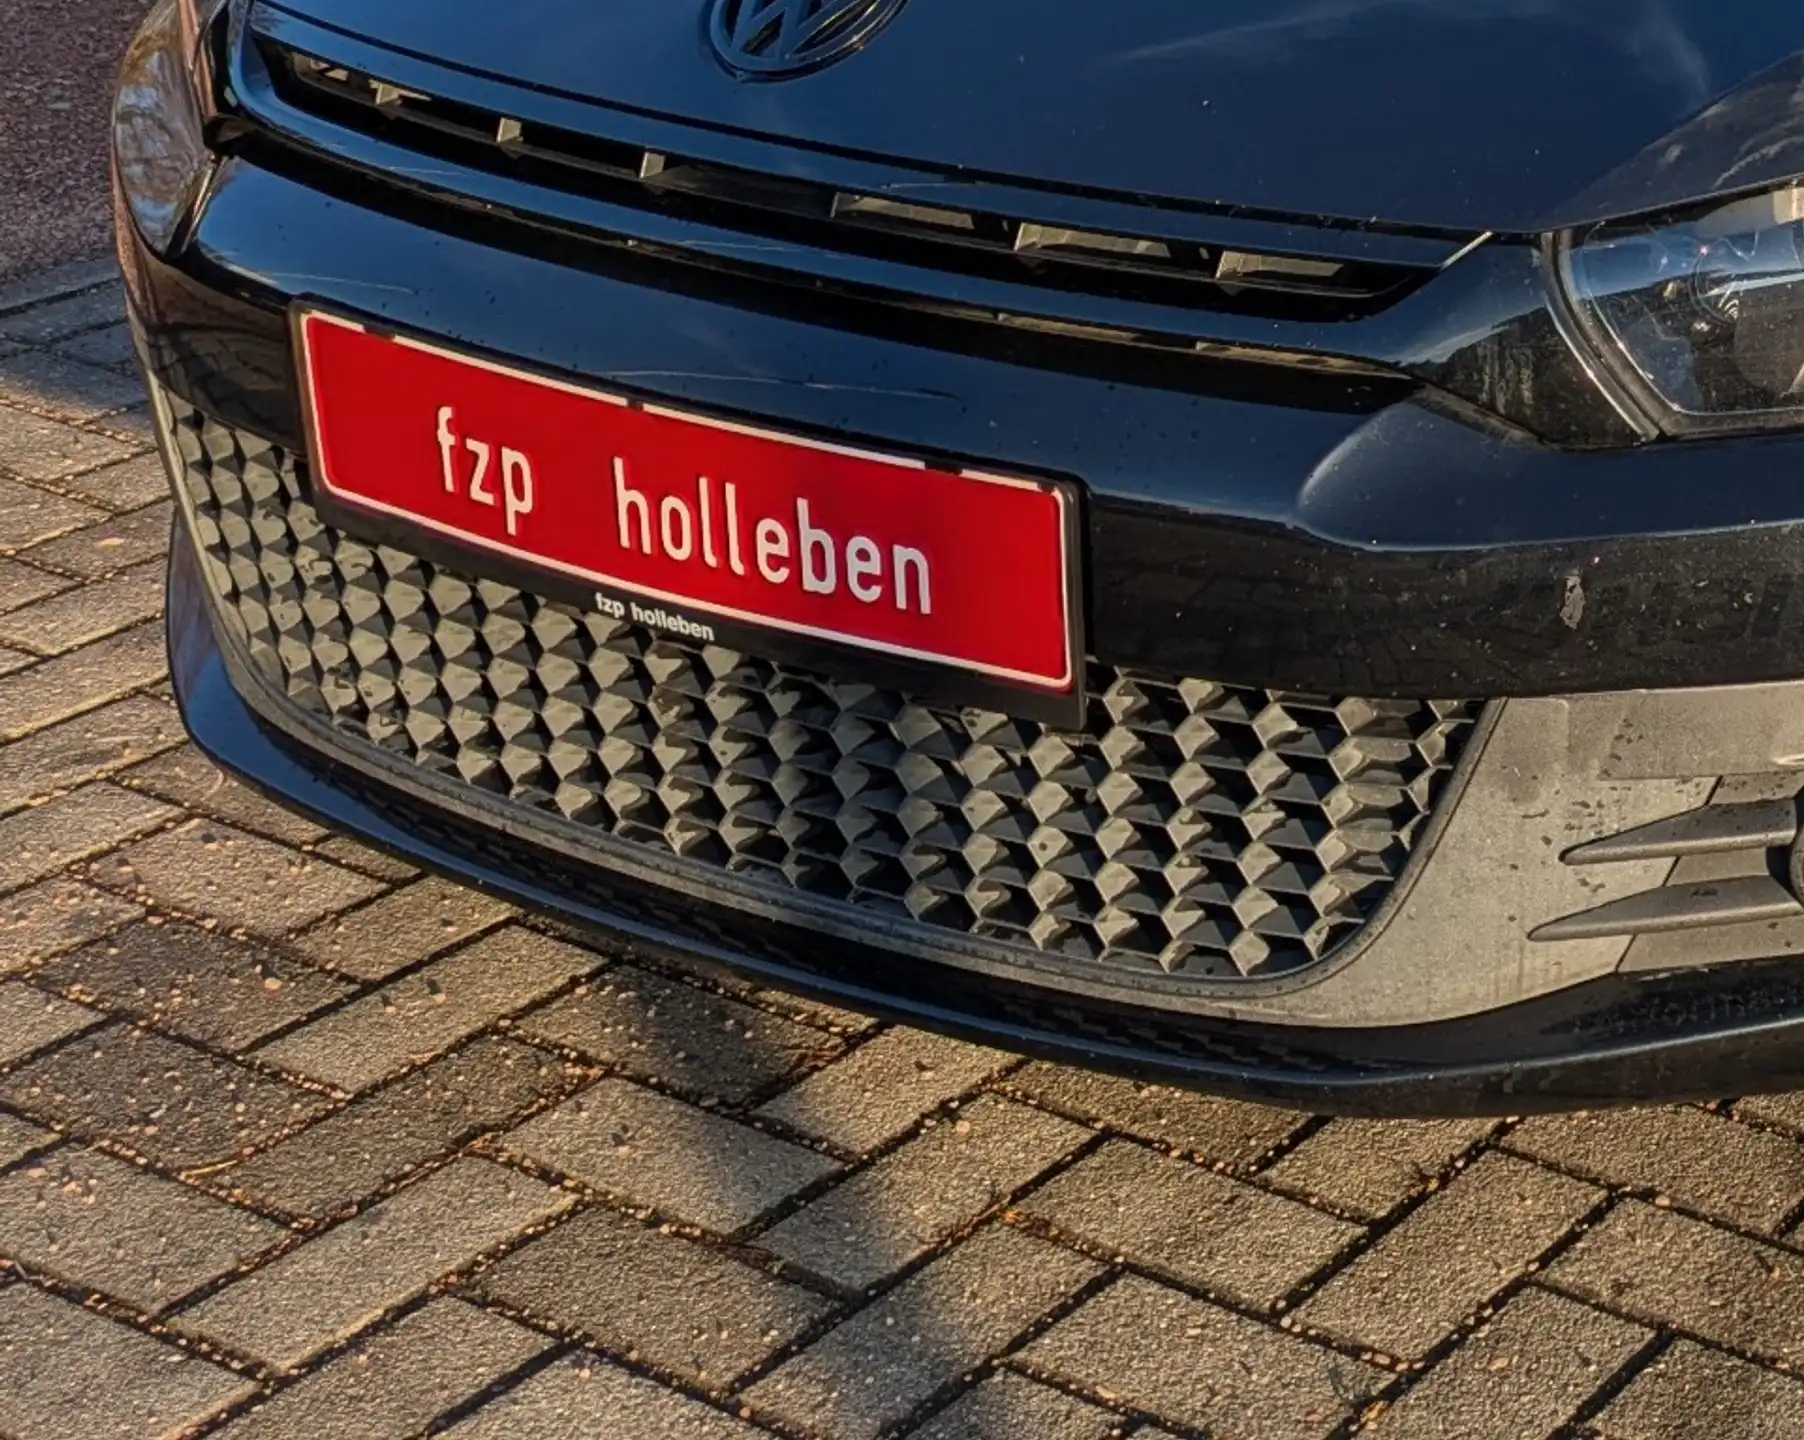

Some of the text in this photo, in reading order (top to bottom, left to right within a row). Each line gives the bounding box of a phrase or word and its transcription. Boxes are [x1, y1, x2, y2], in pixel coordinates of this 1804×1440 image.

[435, 405, 932, 615] fzp holleben
[595, 591, 715, 642] fzp holleben
